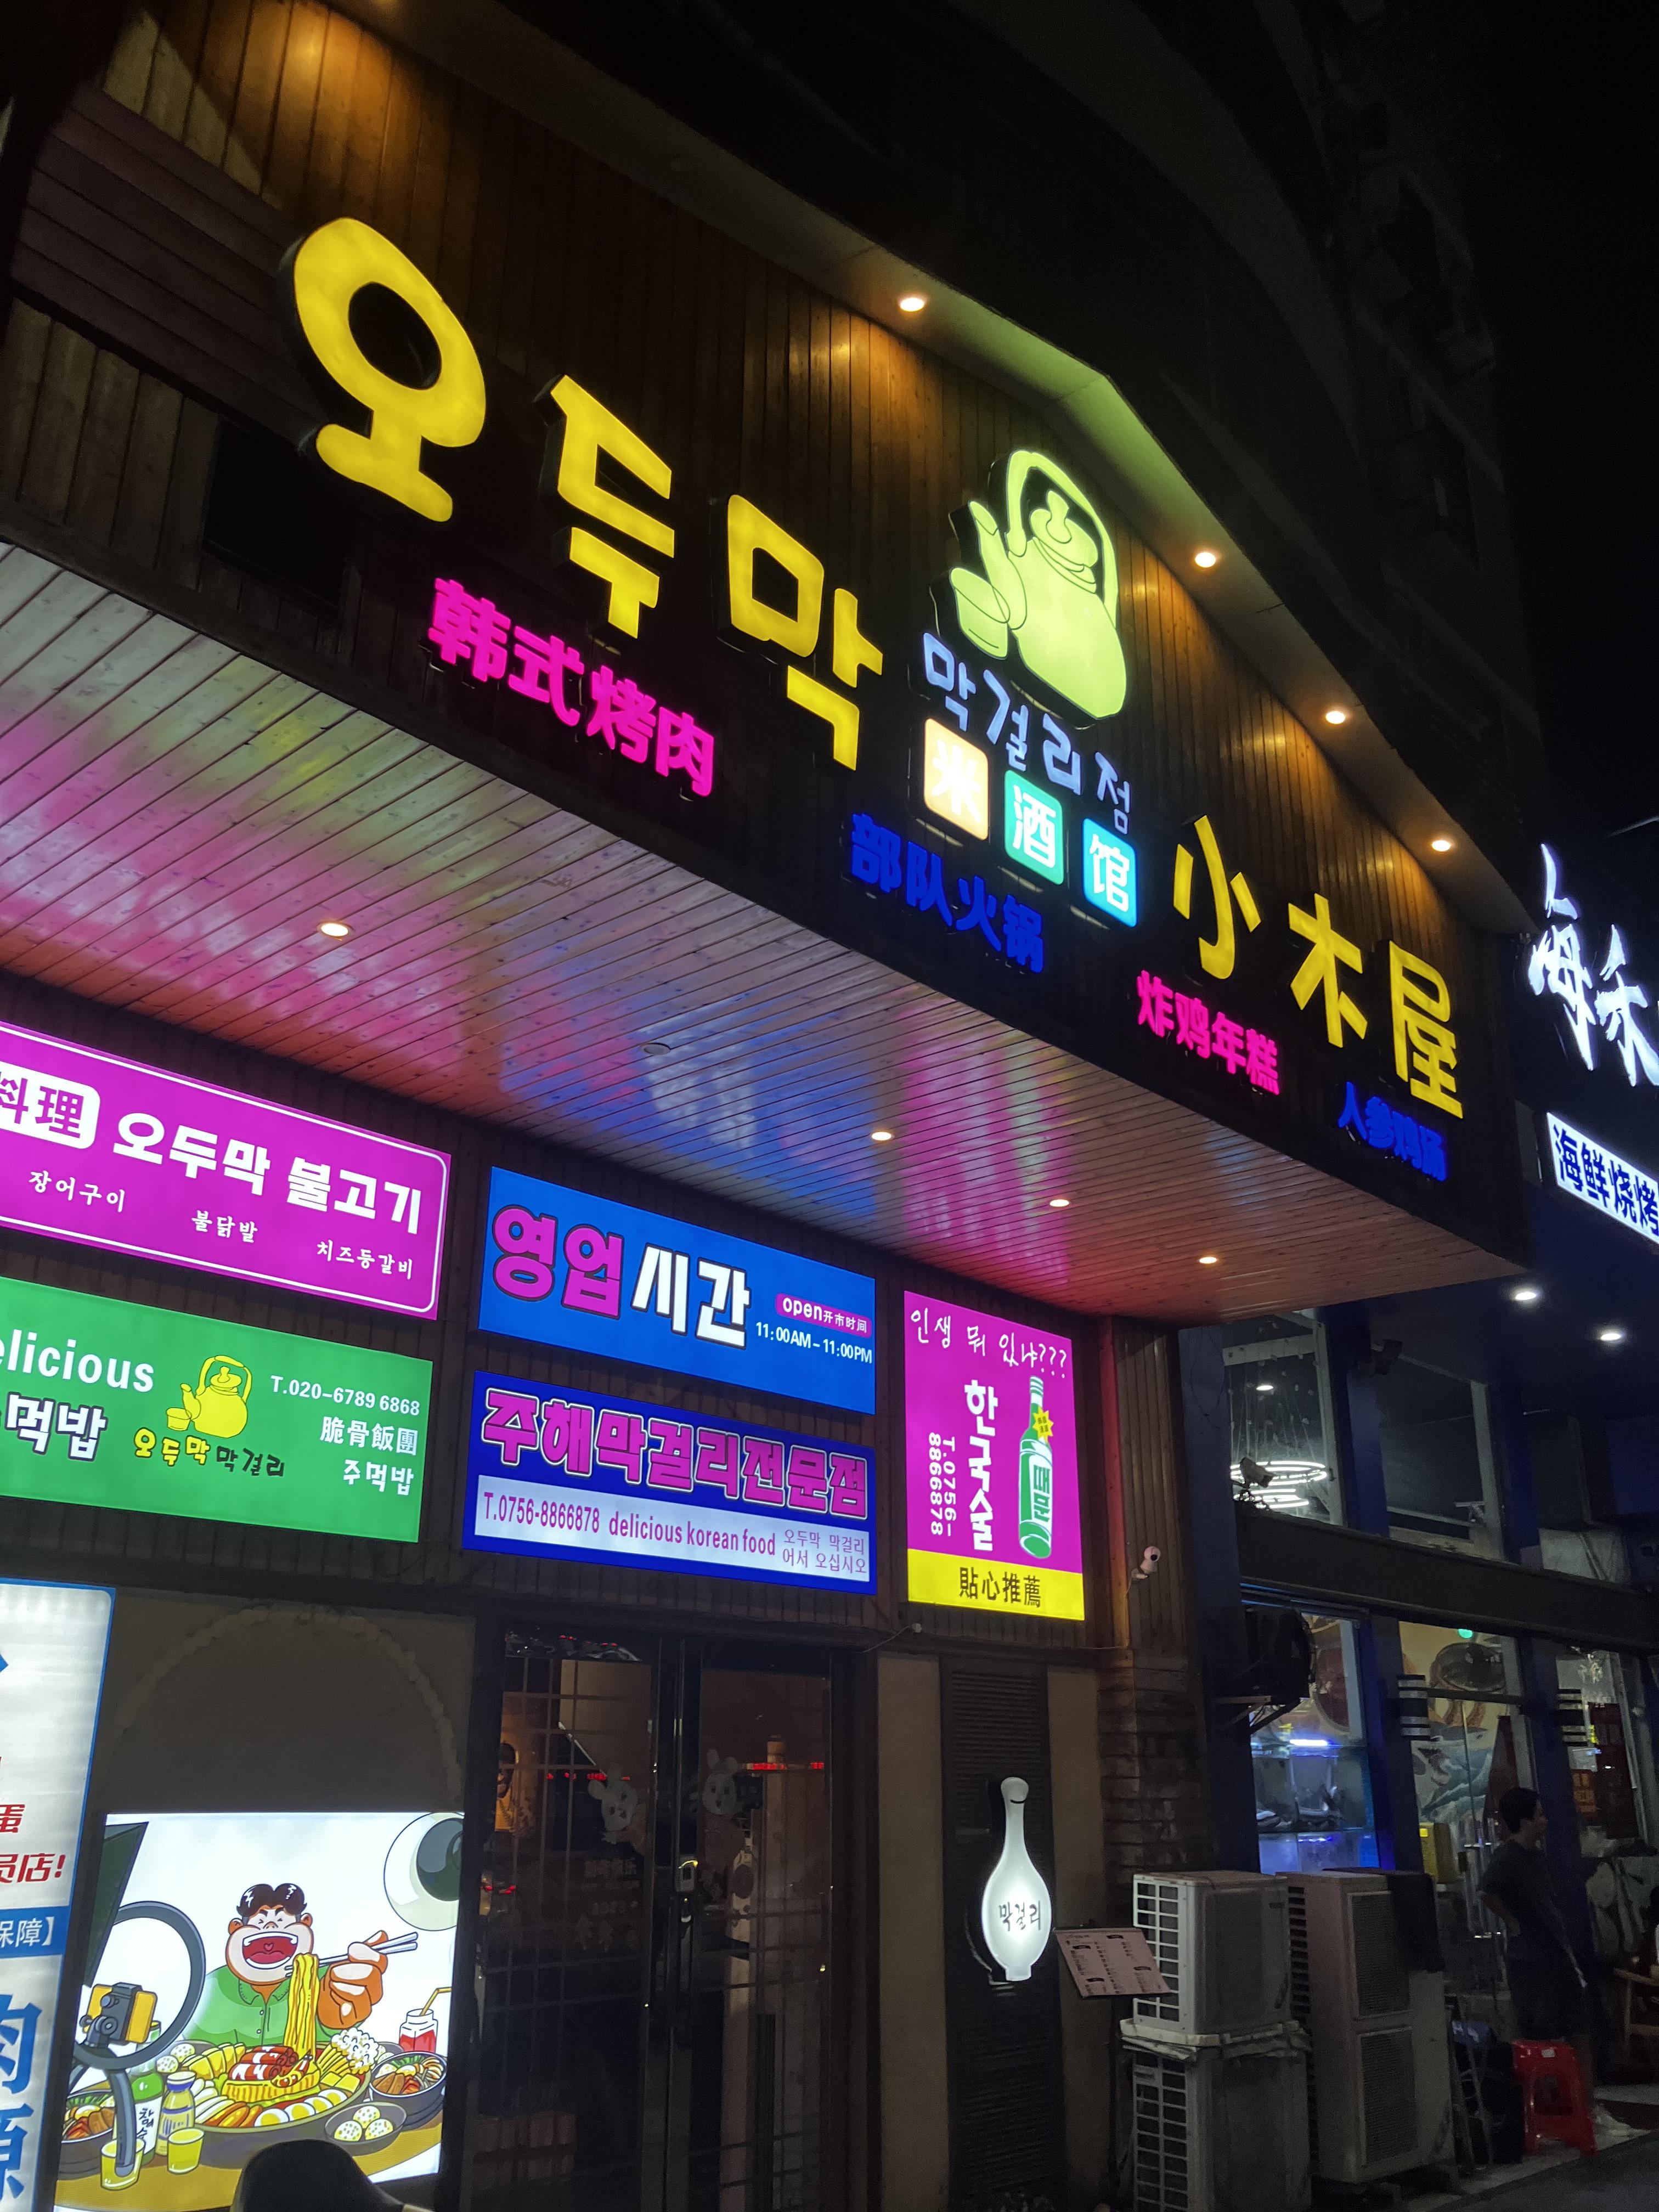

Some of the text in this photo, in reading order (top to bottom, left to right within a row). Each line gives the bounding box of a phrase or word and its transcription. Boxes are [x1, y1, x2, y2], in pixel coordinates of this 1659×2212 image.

[294, 218, 882, 770] 오두막
[428, 578, 714, 796] 韩式烤肉
[923, 633, 1130, 834] 막걸리점
[932, 740, 1130, 912] 米酒馆
[852, 814, 1043, 973] 部队火锅
[1173, 815, 1463, 1119] 小木屋
[1137, 970, 1280, 1095] 炸鸡年糕
[29, 1170, 125, 1212] 장어구이
[112, 1113, 421, 1234] 오두막 불고기
[1553, 1124, 1658, 1236] 海鲜烧烤
[191, 1210, 258, 1243] 불닭발
[317, 1239, 413, 1280] 치즈등갈비
[0, 1329, 155, 1393] licious
[911, 1307, 951, 1348] 인생
[967, 1325, 986, 1357] 뭐
[0, 1391, 108, 1462] 먹밥
[320, 1416, 418, 1456] 脆骨飯團
[379, 1395, 420, 1416] 6868
[134, 1427, 285, 1477] 오두막 막걸리
[343, 1459, 414, 1496] 주먹밥
[929, 1432, 943, 1536] 8866878
[964, 1380, 998, 1551] 한국술
[484, 1492, 776, 1556] T.0756-8866878 delicious korean food
[784, 1529, 864, 1555] 오두막 막걸리
[783, 1548, 867, 1573] 어서 오십시오
[959, 1567, 1042, 1608] 貼心推薦
[999, 1900, 1041, 1932] 막걸리
